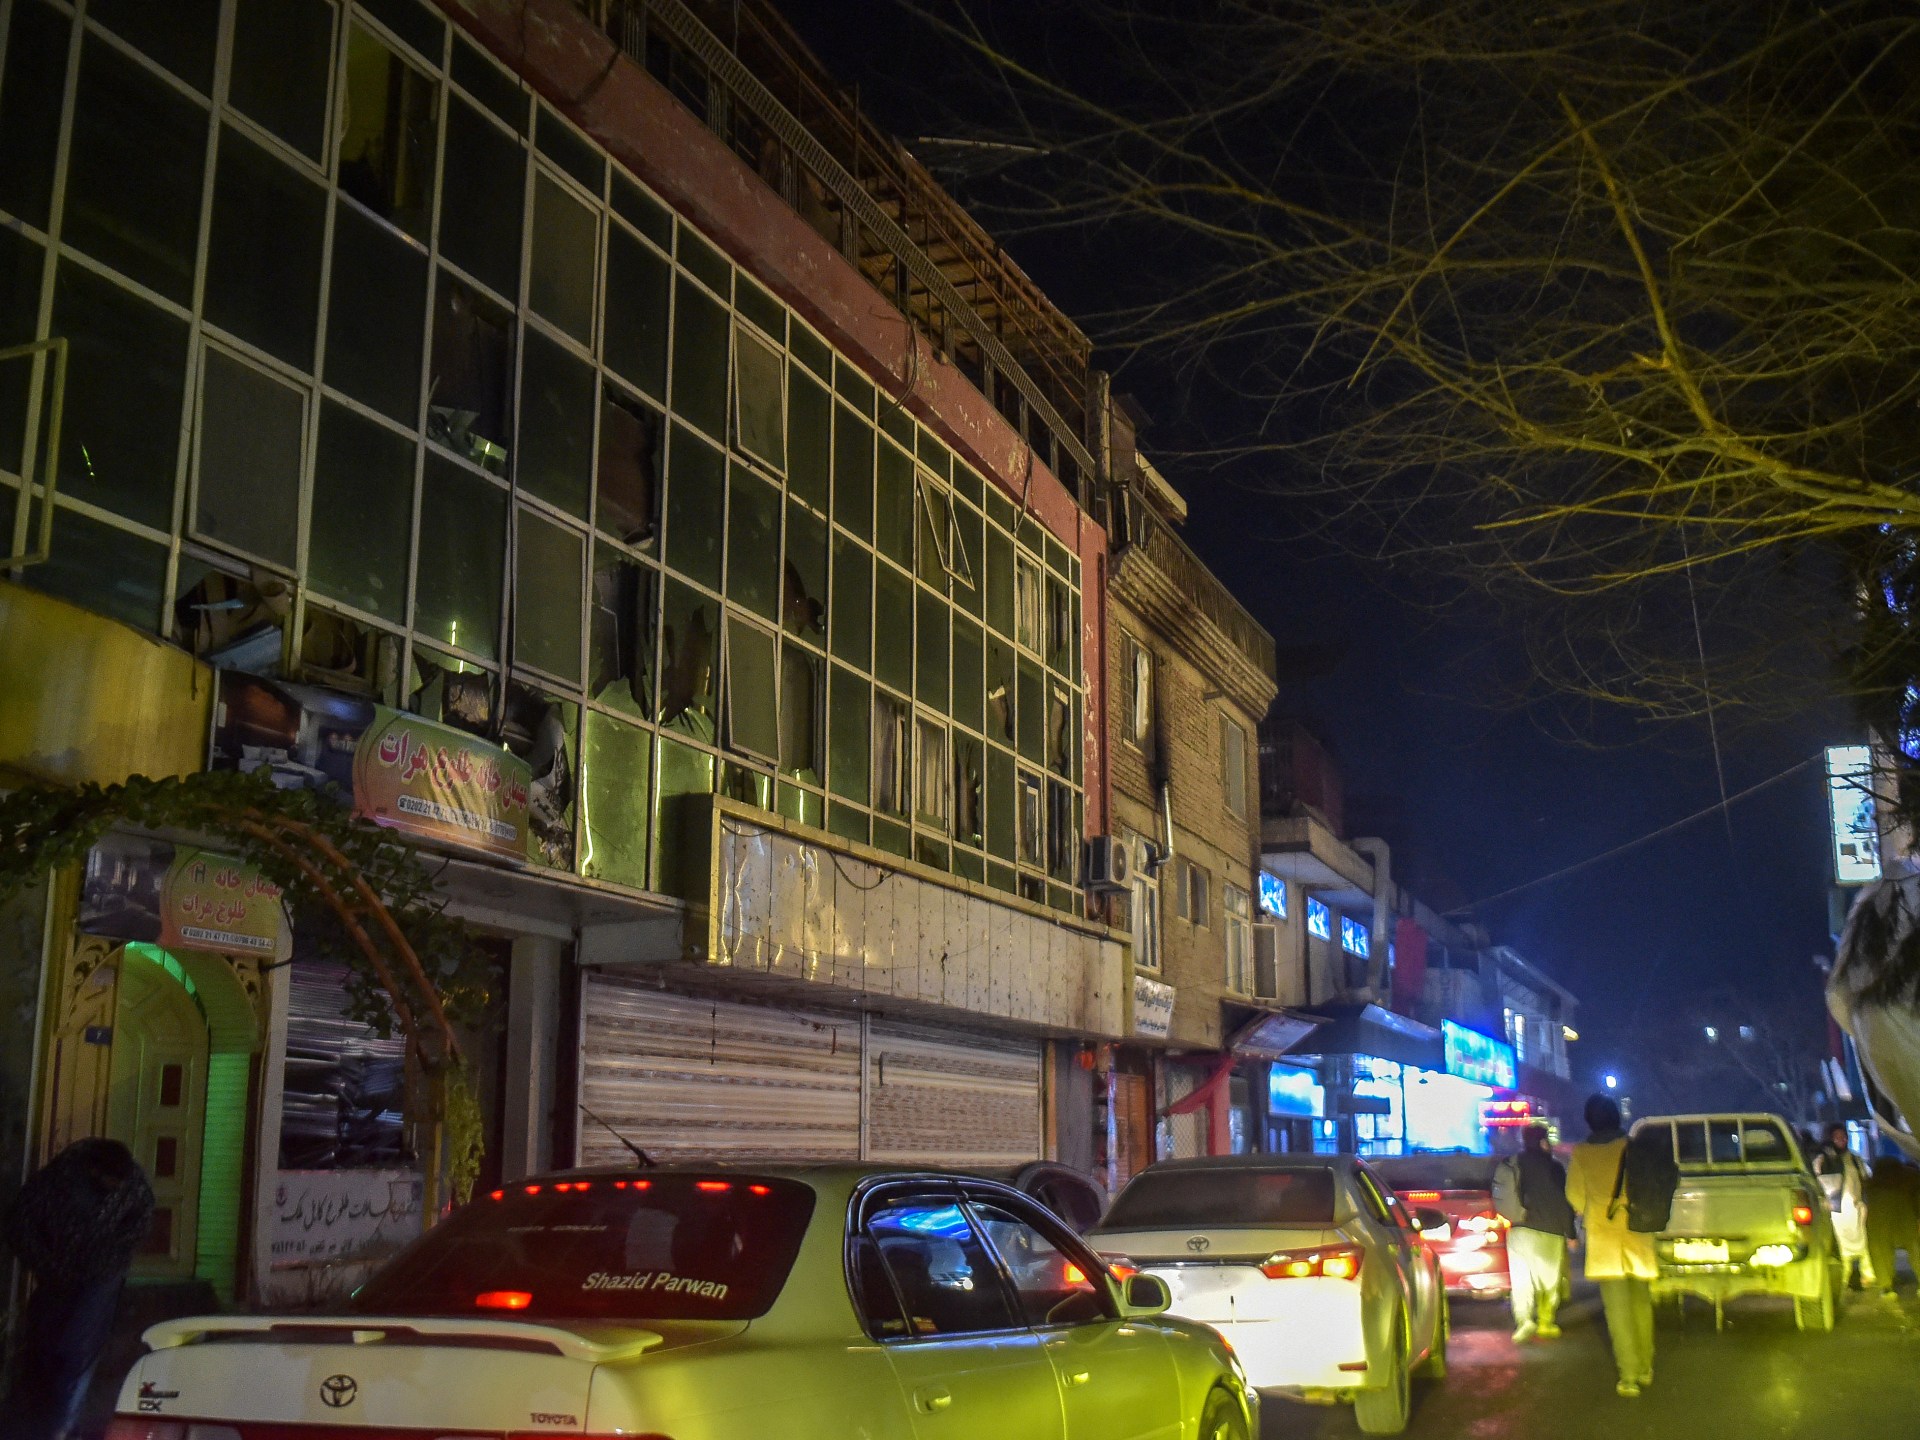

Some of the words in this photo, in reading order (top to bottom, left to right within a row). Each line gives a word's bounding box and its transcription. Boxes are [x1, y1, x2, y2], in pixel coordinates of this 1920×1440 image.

[378, 731, 429, 783] هرات
[215, 867, 240, 888] خانه
[182, 894, 213, 920] هرات
[582, 1271, 652, 1290] Shazid
[651, 1272, 728, 1300] Parwan
[530, 1412, 577, 1425] TOYOTA
